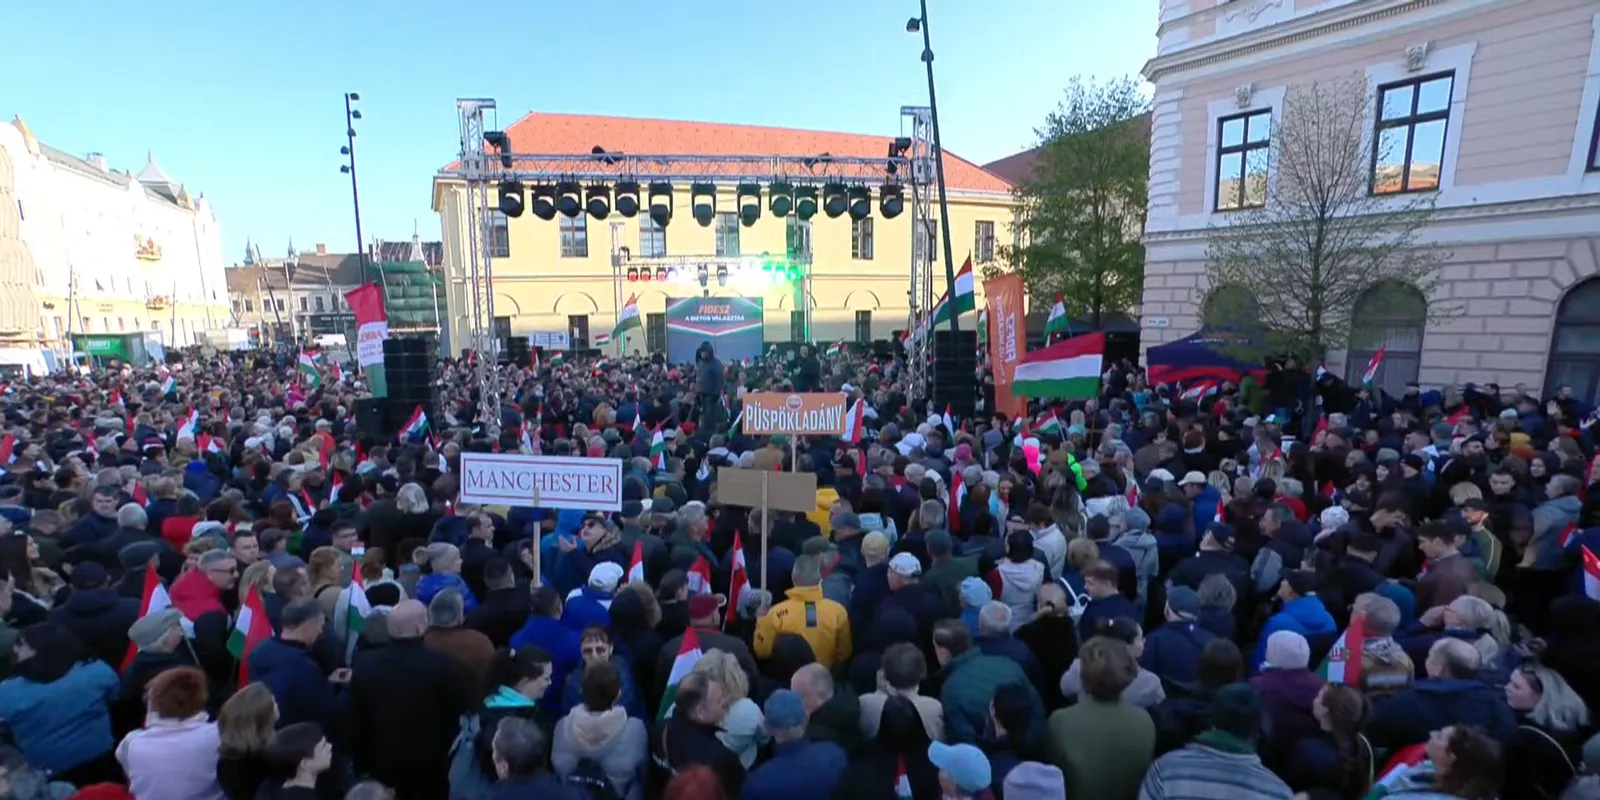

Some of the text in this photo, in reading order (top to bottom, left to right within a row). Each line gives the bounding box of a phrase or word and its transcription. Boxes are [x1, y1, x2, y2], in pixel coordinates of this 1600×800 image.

[699, 304, 731, 314] FIDESZ
[746, 400, 842, 431] PÜSPÖKLADÁNY
[467, 469, 614, 494] MANCHESTER
